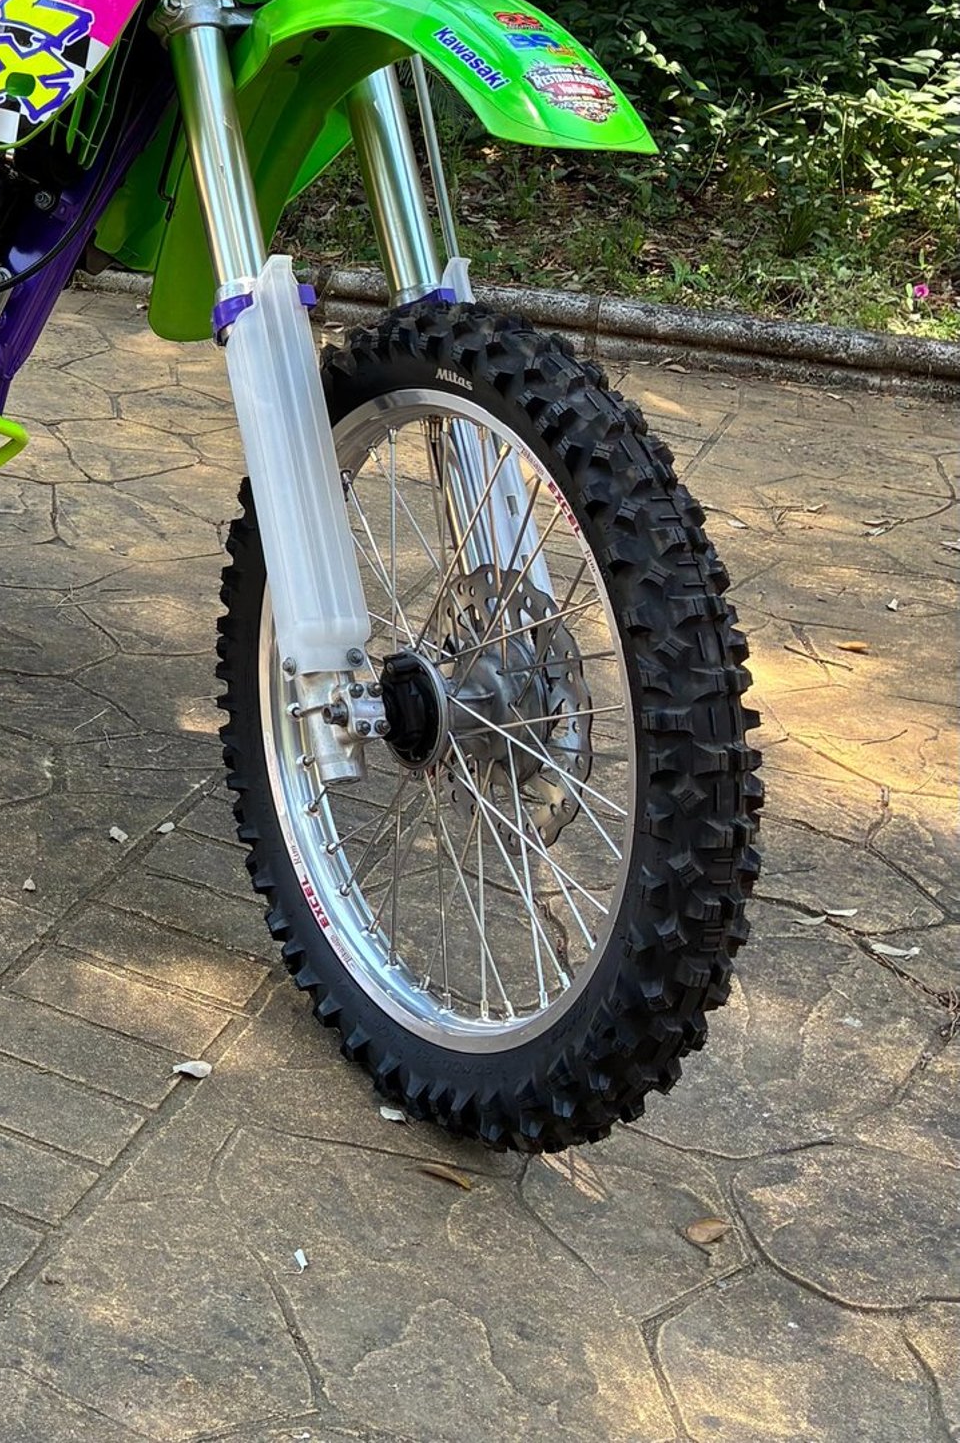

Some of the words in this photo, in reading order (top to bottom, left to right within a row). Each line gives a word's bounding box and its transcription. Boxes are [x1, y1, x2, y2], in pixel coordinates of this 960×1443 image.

[433, 27, 511, 90] Kawasaki
[435, 367, 473, 391] Mitas
[548, 480, 581, 539] EXCEL
[300, 874, 331, 929] EXCEL
